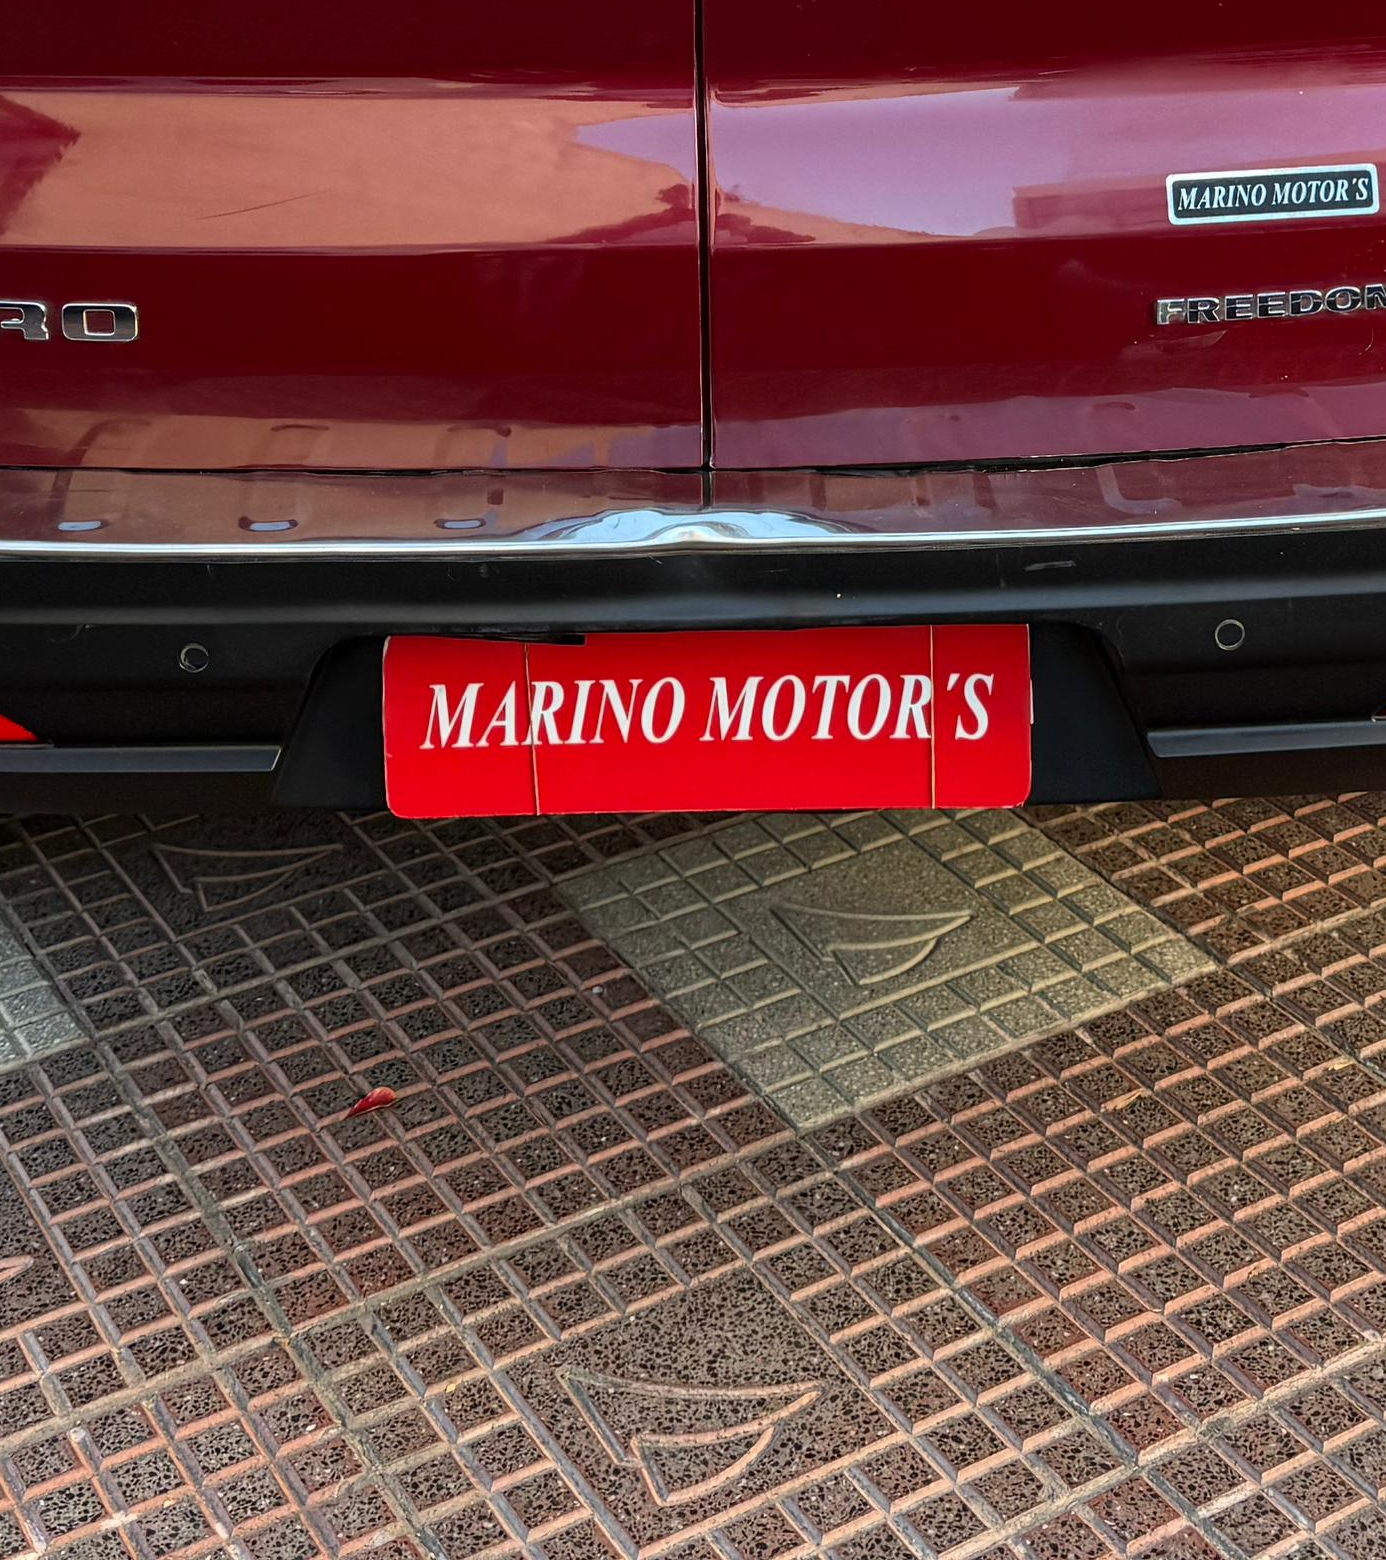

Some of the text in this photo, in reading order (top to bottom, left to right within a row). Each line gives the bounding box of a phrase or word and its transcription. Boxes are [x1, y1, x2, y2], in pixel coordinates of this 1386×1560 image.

[1177, 182, 1267, 211] MARINO
[419, 672, 995, 750] MARINO MOTOR'S
